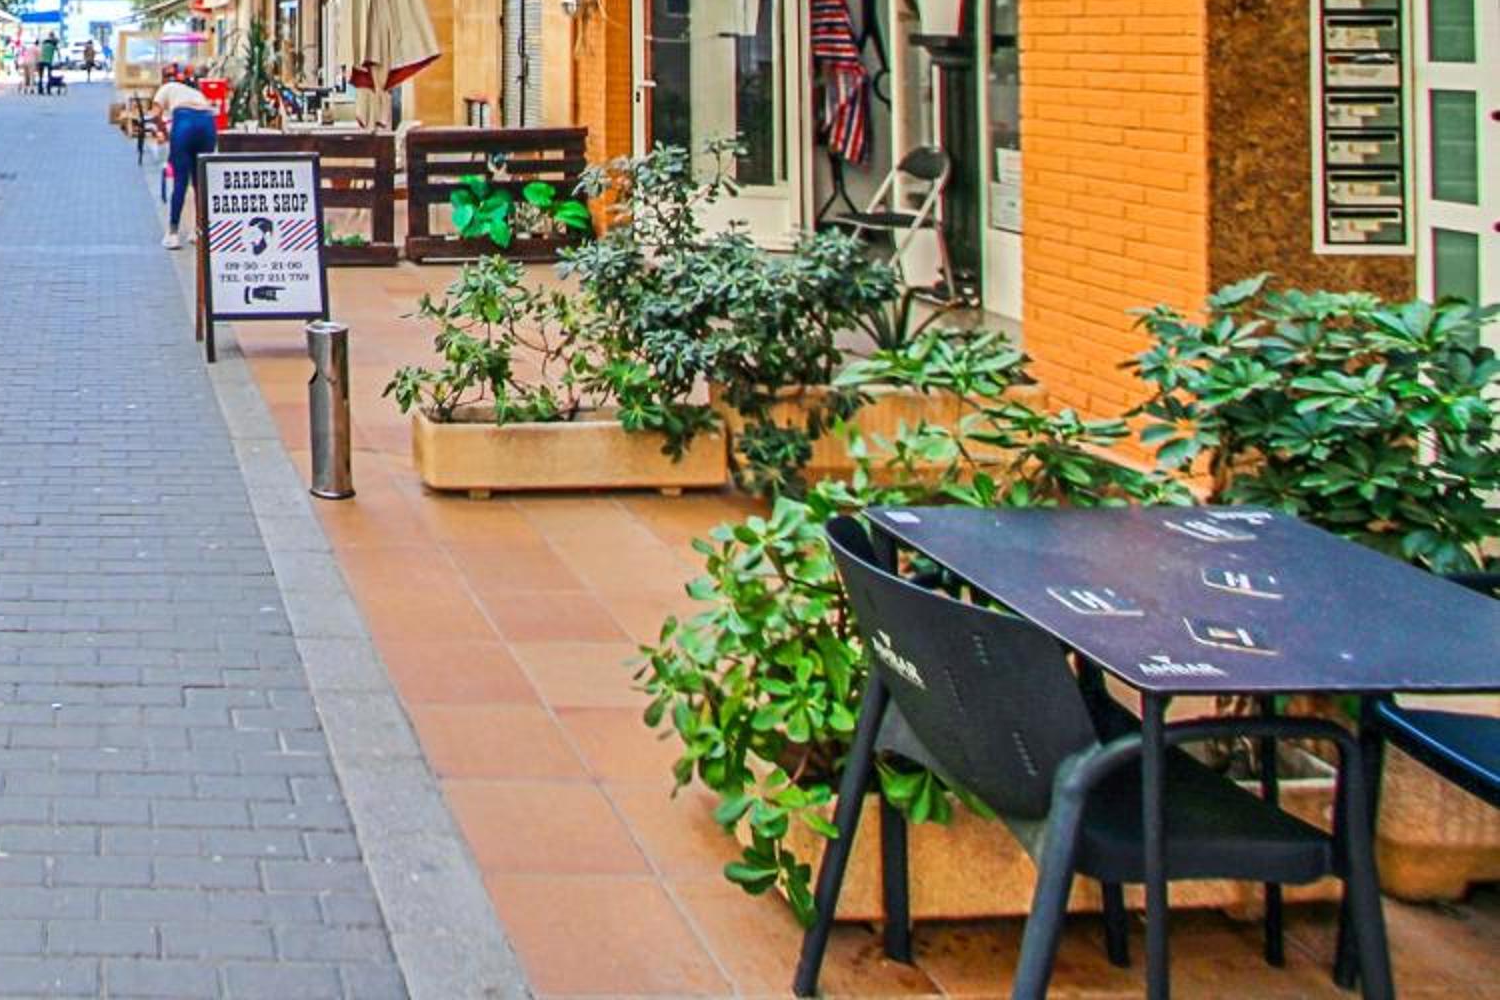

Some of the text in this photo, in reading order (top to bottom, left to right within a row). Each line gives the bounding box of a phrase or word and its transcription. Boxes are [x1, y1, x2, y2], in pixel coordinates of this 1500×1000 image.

[223, 170, 295, 189] BARBERIA
[212, 193, 309, 213] BARBER SHOP
